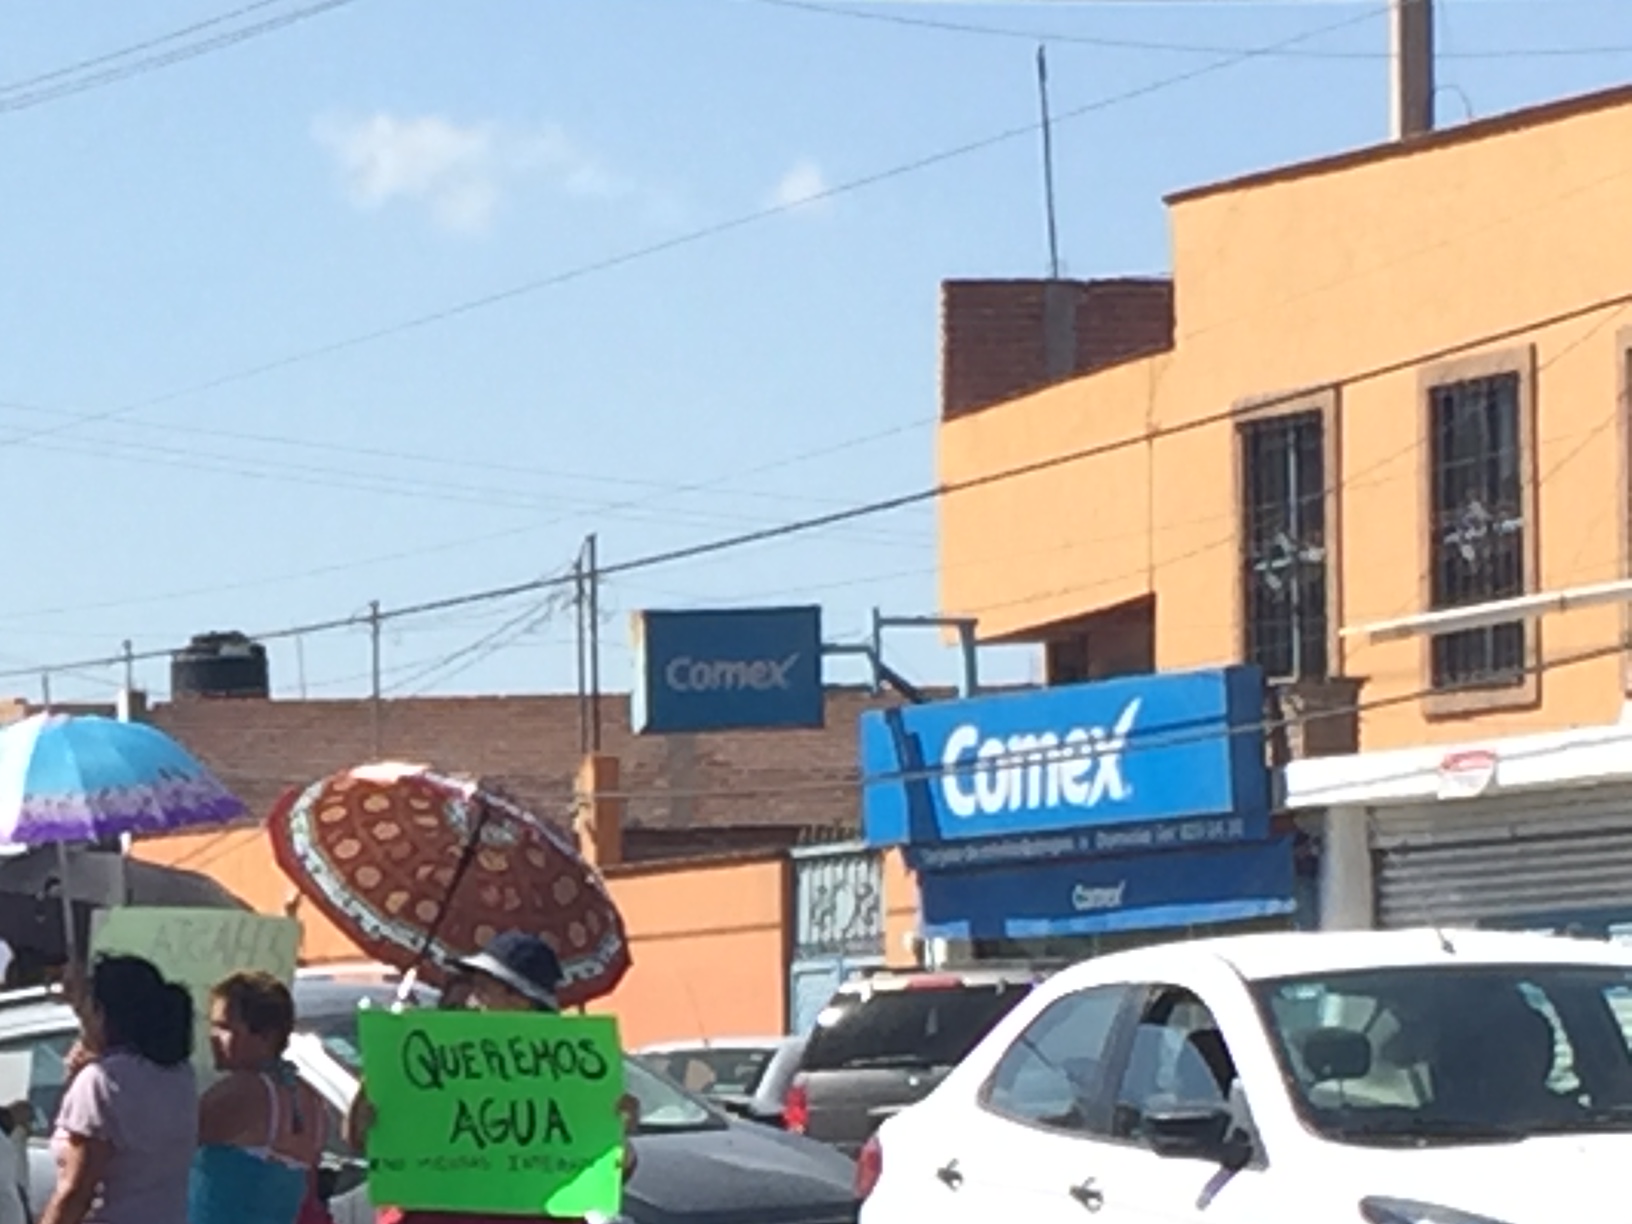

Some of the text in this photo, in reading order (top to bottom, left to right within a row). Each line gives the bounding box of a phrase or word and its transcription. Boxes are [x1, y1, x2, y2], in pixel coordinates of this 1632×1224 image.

[665, 652, 800, 691] Comex
[942, 697, 1142, 817] Comex
[402, 1029, 608, 1090] QUEREMOS
[448, 1096, 573, 1149] AGUA
